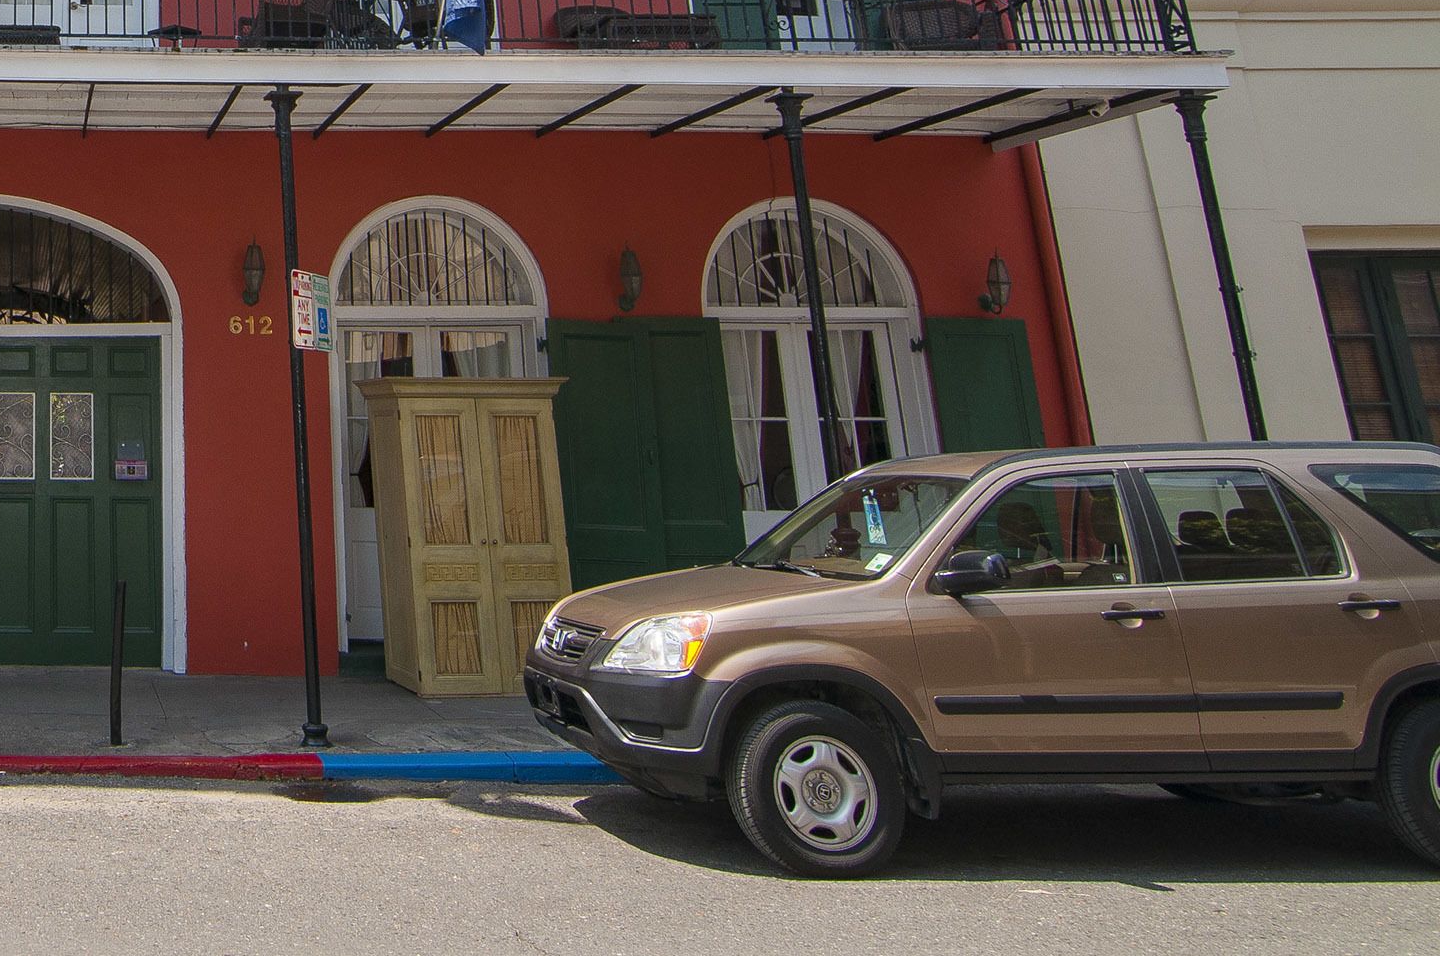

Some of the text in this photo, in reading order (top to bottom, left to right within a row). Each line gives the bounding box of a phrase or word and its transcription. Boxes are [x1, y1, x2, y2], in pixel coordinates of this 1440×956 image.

[297, 299, 310, 312] ANY
[229, 315, 273, 334] 612
[298, 312, 311, 325] TIME
